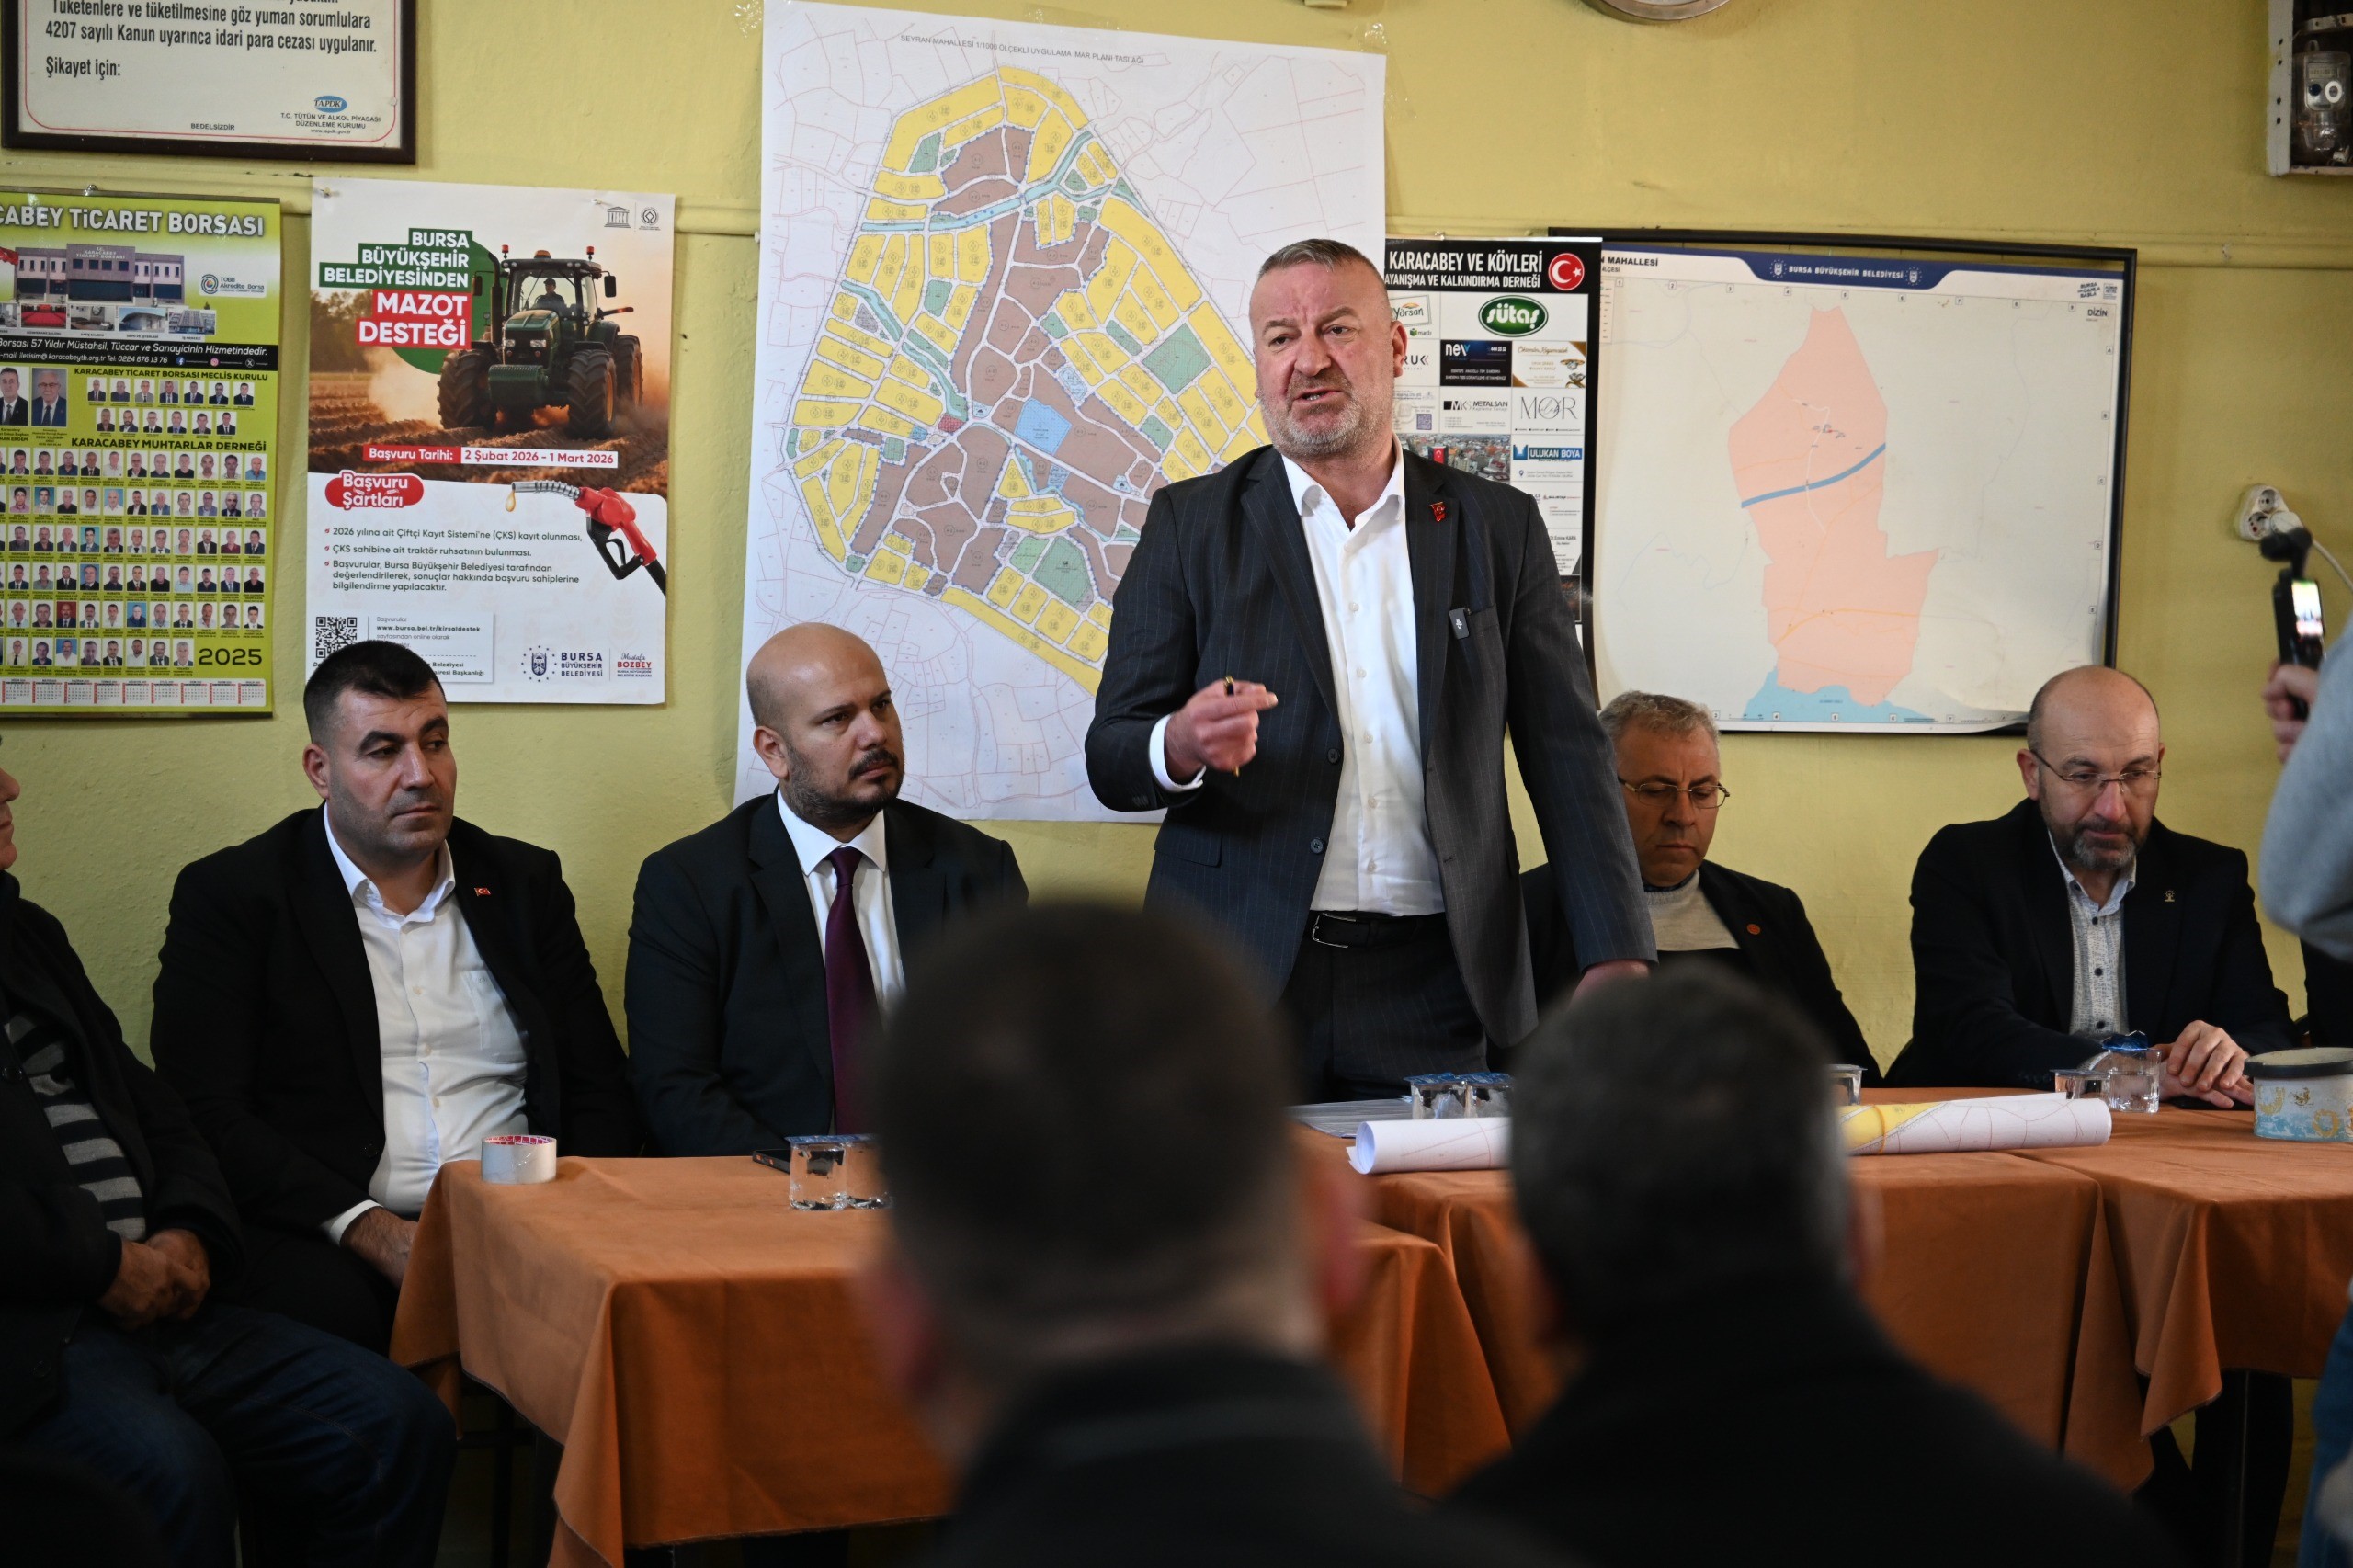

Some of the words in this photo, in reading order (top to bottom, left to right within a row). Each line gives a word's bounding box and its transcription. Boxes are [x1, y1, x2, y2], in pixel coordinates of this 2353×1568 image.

[128, 6, 142, 17] ve
[146, 2, 227, 22] tüketilmesine
[231, 6, 251, 26] göz
[256, 10, 295, 27] yuman
[299, 11, 370, 28] sorumlulara
[46, 20, 76, 39] 4207
[81, 24, 113, 43] sayılı
[118, 24, 155, 42] Kanun
[160, 29, 211, 47] uyarınca
[215, 29, 243, 46] idari
[247, 34, 274, 50] para
[278, 35, 315, 50] cezası
[319, 36, 377, 54] uygulanır.
[901, 35, 931, 44] SEYRAN
[932, 37, 974, 48] MAHALLESİ
[976, 41, 998, 51] 1/1000
[1030, 46, 1072, 58] UYGULAMA
[1073, 48, 1091, 60] İMAR
[1092, 51, 1113, 62] PLANI
[1114, 53, 1144, 64] TASLAĞI
[46, 56, 91, 78] Şikayet
[95, 59, 121, 81] için:
[313, 98, 342, 108] TAPDK
[294, 112, 315, 120] TÜTÜN
[352, 114, 381, 123] PİYASASI
[295, 119, 335, 129] DÜZENLEME
[337, 121, 366, 130] KURUMU
[190, 122, 235, 131] BEDELSİZDİR
[0, 205, 63, 228] ABEY
[168, 212, 265, 237] BORSASI
[411, 230, 470, 249] BURSA
[361, 246, 470, 269] BÜYÜKŞEHİR
[1389, 250, 1463, 272] KARACABEY
[1467, 253, 1483, 271] VE
[1487, 248, 1543, 273] KÖYLERİ
[1607, 256, 1659, 267] MAHALLESİ
[324, 264, 469, 289] BELEDİYESİNDEN
[1789, 266, 1813, 274] BURSA
[1814, 267, 1859, 278] BÜYÜKŞEHİR
[1862, 269, 1904, 279] BELEDİYESİ
[1385, 275, 1425, 289] AYANIŞMA
[1427, 275, 1438, 287] VE
[1440, 275, 1500, 289] KALKINDIRMA
[1503, 274, 1540, 289] DERNEĞİ
[376, 291, 468, 317] MAZOT
[2087, 307, 2108, 317] DİZİN
[358, 319, 466, 346] DESTEĞİ
[31, 338, 42, 347] 57
[44, 338, 64, 348] Yıldır
[111, 341, 139, 351] Tüccar
[153, 343, 203, 355] Sanayicinin
[205, 345, 267, 357] Hizmetindedir.
[74, 368, 125, 376] KARACABEY
[126, 369, 161, 377] TİCARET
[162, 370, 199, 379] BORSASI
[200, 370, 233, 380] MECLİS
[233, 372, 268, 381] KURULU
[1472, 400, 1508, 408] METALSAN
[72, 437, 140, 449] KARACABEY
[142, 439, 213, 450] MUHTARLAR
[216, 440, 267, 452] DERNEĞİ
[369, 448, 415, 461] Başvuru
[418, 449, 454, 461] Tarihi:
[464, 449, 471, 460] 2
[474, 449, 508, 464] Şubat
[511, 450, 540, 462] 2026
[550, 452, 554, 462] 1
[557, 452, 584, 464] Mart
[586, 453, 614, 465] 2026
[1529, 449, 1560, 458] ULUKAN
[1561, 449, 1581, 458] BOYA
[342, 473, 408, 491] Başvuru
[342, 489, 404, 509] Şartları
[332, 528, 354, 537] 2026
[356, 528, 381, 540] yılına
[382, 528, 395, 538] ait
[397, 528, 421, 540] Çiftçi
[422, 530, 445, 540] Kayıt
[493, 531, 517, 541] (ÇKS)
[518, 531, 540, 542] kayıt
[541, 532, 583, 542] olunması,
[332, 544, 351, 554] ÇKS
[353, 544, 392, 554] sahibine
[393, 545, 405, 554] ait
[407, 546, 438, 555] traktör
[439, 547, 482, 557] ruhsatının
[484, 548, 532, 558] bulunması.
[332, 561, 382, 571] Başvurular,
[384, 562, 409, 570] Bursa
[411, 562, 459, 573] Büyükşehir
[460, 562, 505, 573] Belediyesi
[506, 563, 552, 573] tarafından
[332, 571, 411, 583] değerlendirilerek,
[413, 573, 450, 583] sonuçlar
[453, 574, 494, 583] hakkında
[495, 574, 530, 585] başvuru
[532, 574, 579, 586] sahiplerine
[332, 582, 391, 593] bilgilendirme
[392, 583, 447, 594] yapılacaktır.
[198, 647, 263, 665] 2025
[561, 652, 603, 662] BURSA
[561, 661, 603, 670] BÜYÜKŞEHİR
[561, 668, 603, 677] BELEDİYESİ
